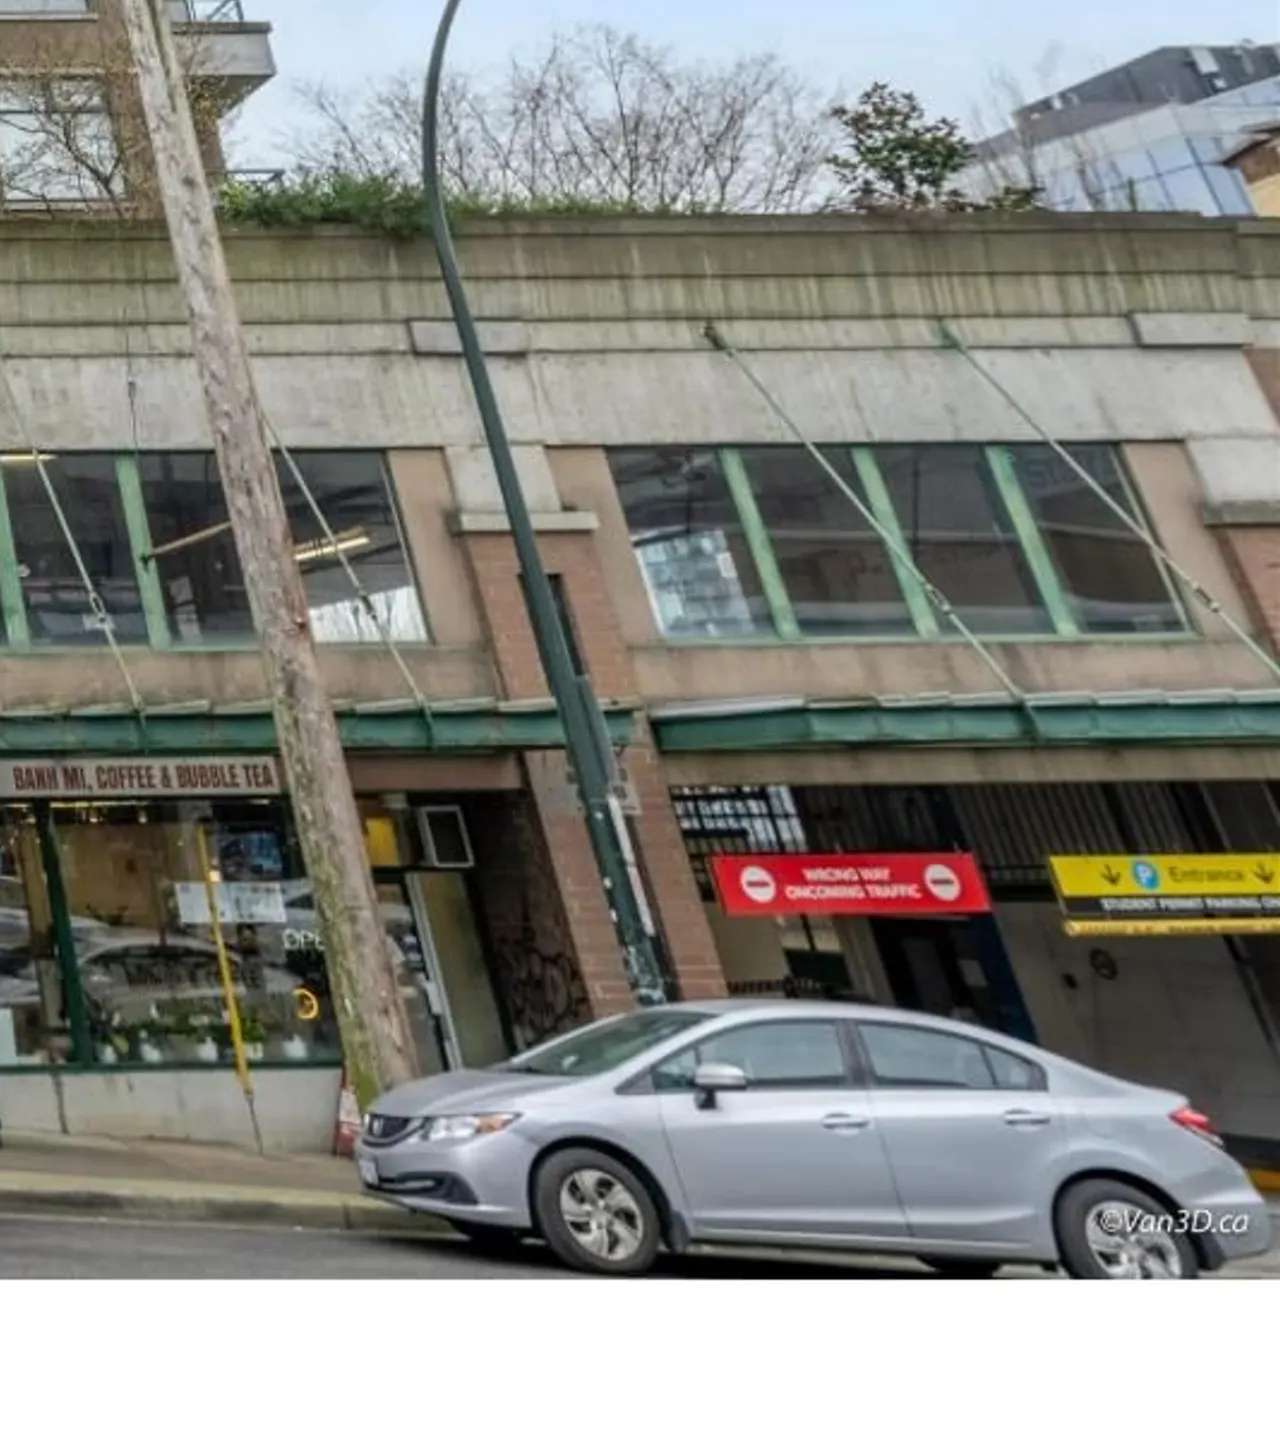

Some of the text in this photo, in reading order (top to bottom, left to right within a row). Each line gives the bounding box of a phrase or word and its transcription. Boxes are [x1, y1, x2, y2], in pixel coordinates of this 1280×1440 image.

[13, 766, 59, 790] BANH
[96, 765, 158, 789] COFFEE
[160, 765, 173, 788] &
[175, 764, 240, 788] BUBBLE
[242, 763, 275, 787] TEA
[801, 866, 892, 882] WRONG WAY
[1167, 866, 1245, 884] Entrance
[783, 883, 924, 900] ONCOMING TRAFFIC
